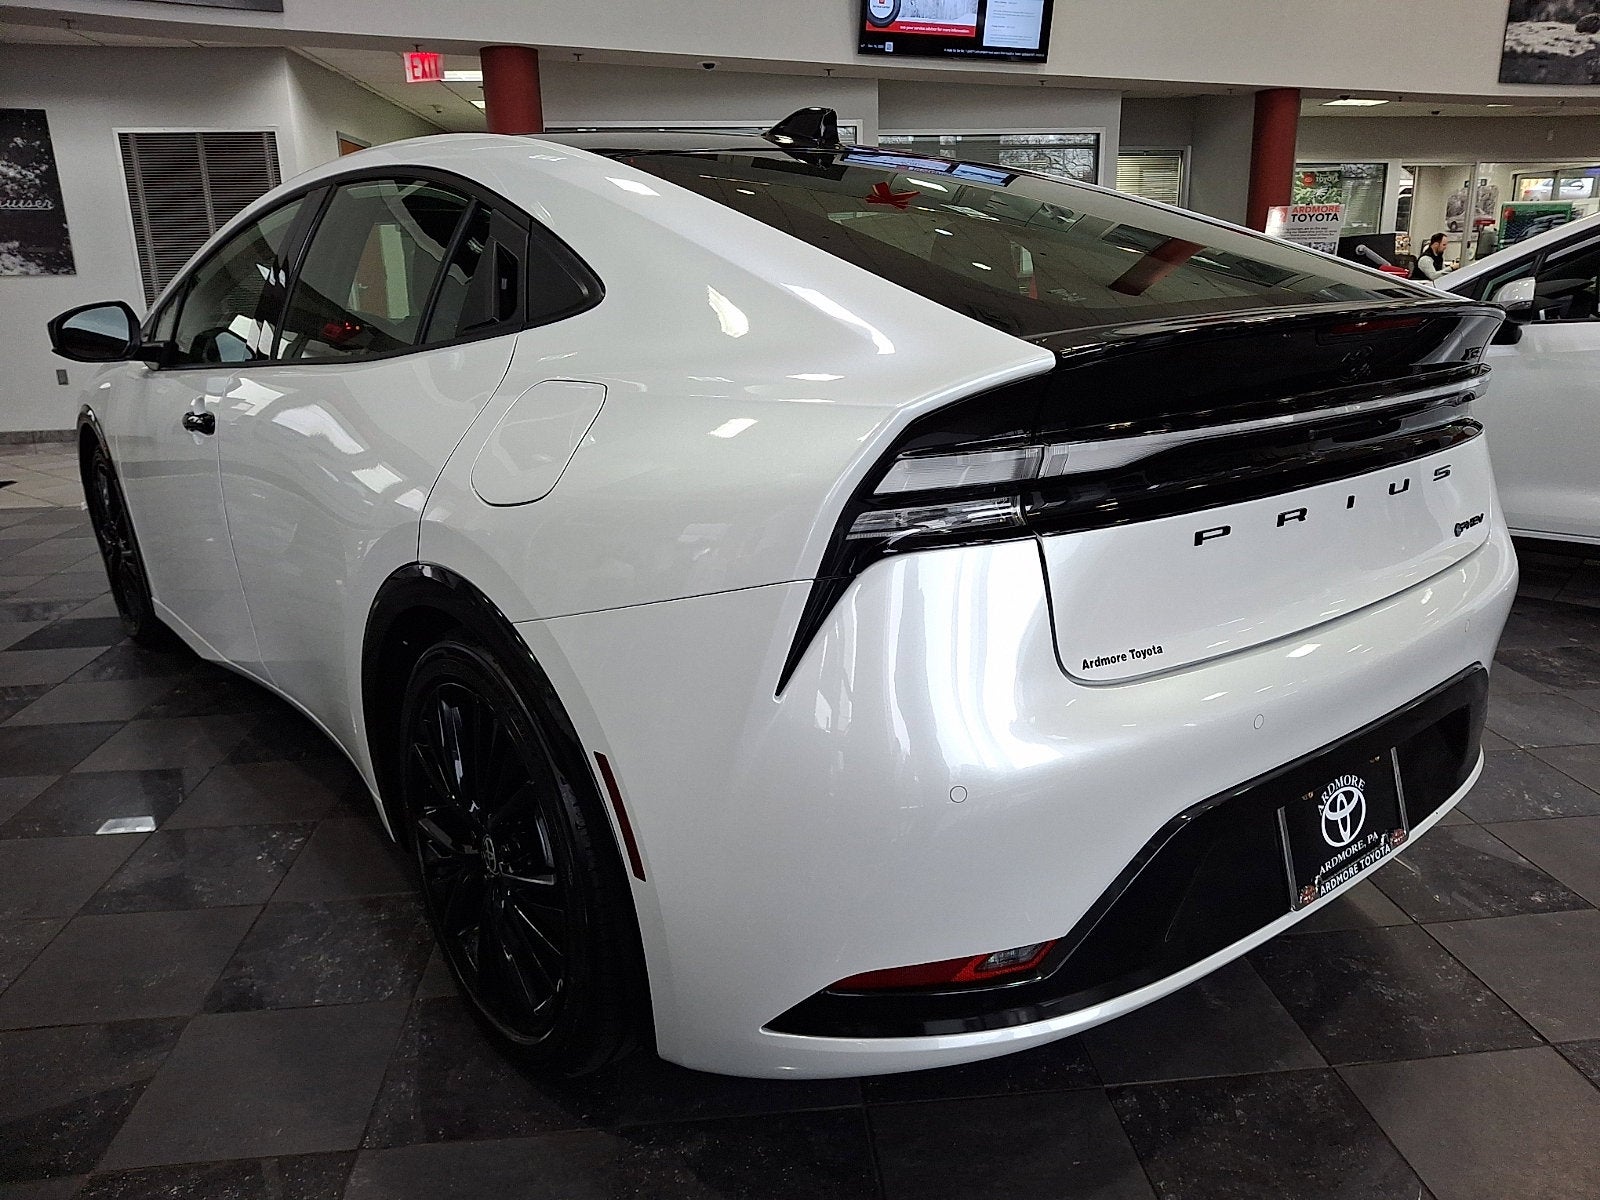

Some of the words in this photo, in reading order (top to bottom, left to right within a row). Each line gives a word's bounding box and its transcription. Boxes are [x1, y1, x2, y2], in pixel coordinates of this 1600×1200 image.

[410, 54, 440, 80] EXIT
[1291, 212, 1339, 223] TOYOTA
[1292, 205, 1340, 213] ARDMORE
[1194, 464, 1452, 547] PRIUS
[1082, 655, 1128, 671] Ardmore
[1128, 644, 1164, 660] Toyota
[1318, 774, 1366, 817] ARDMORE
[1367, 831, 1379, 845] PA
[1320, 865, 1359, 897] ARDMORE
[1359, 843, 1392, 870] TOYOTA
